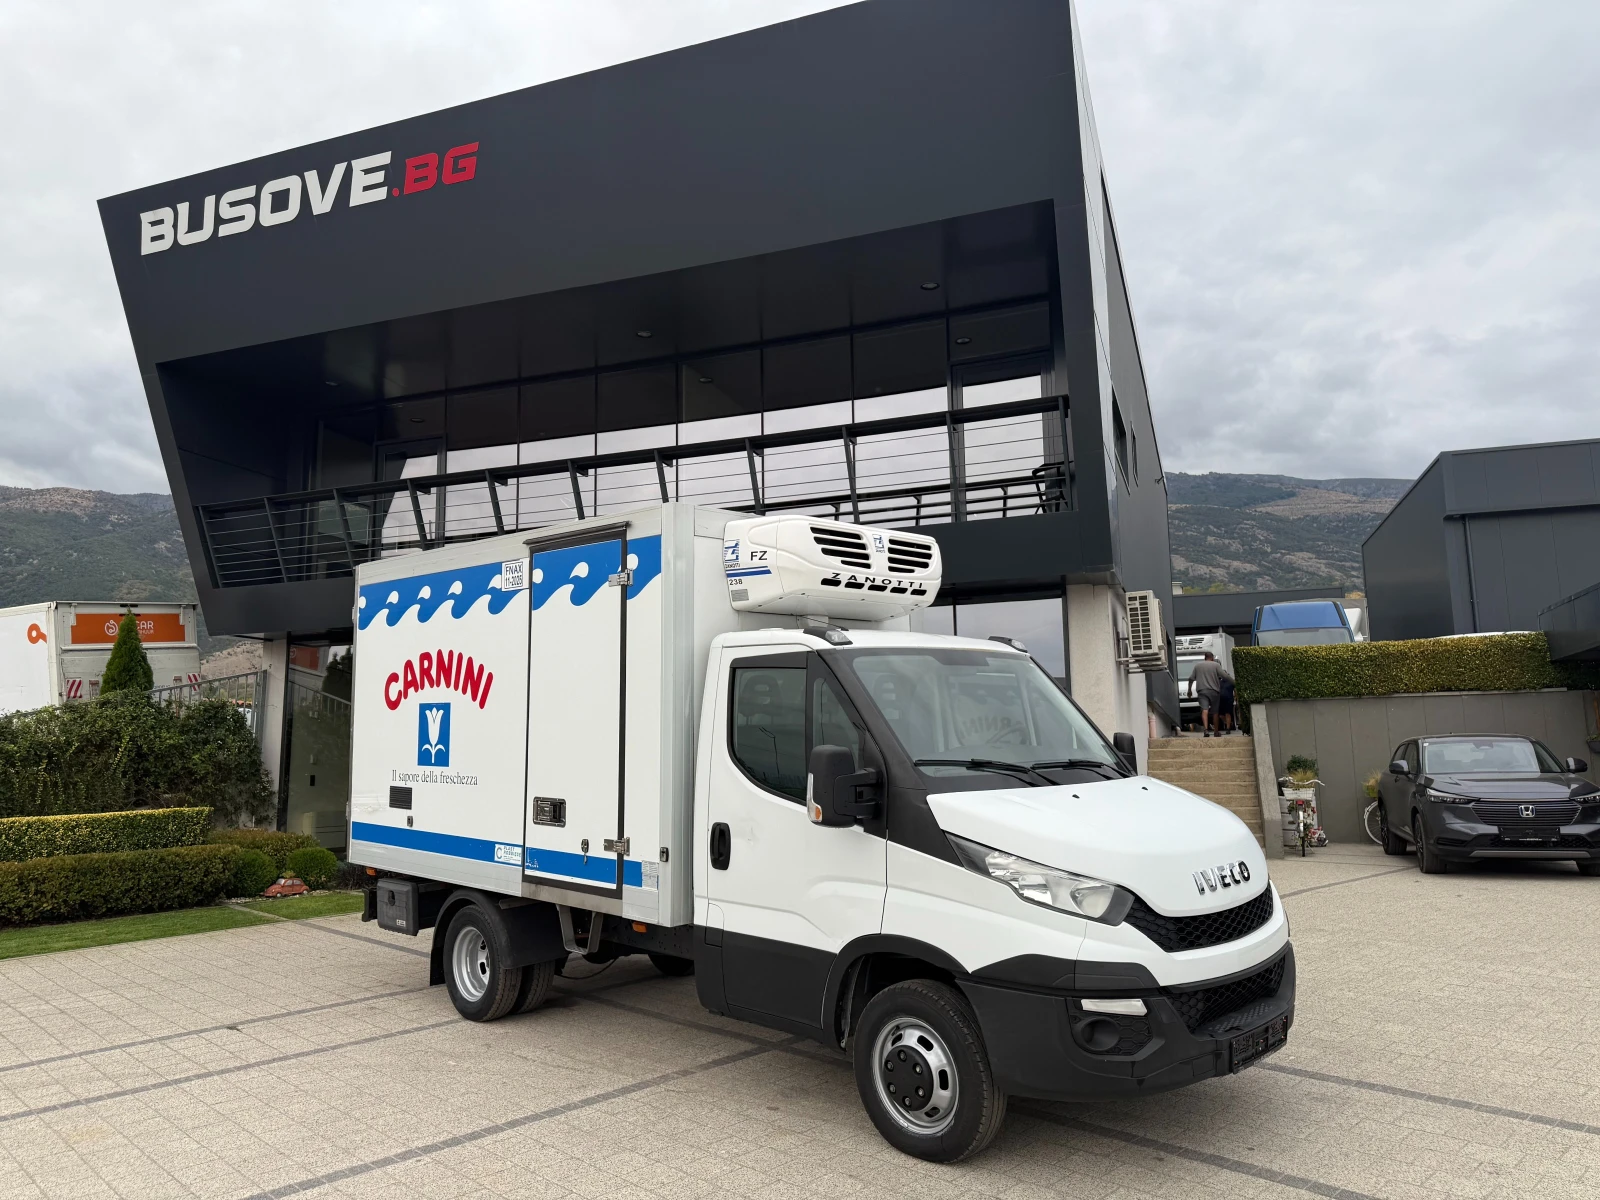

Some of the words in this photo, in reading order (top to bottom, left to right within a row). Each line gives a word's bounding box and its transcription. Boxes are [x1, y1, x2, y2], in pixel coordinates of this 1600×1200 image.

[750, 550, 768, 561] FZ
[505, 563, 523, 576] FNAX
[728, 578, 743, 586] 238
[831, 572, 923, 589] ZANOTTI
[384, 648, 494, 711] CARNINI
[392, 769, 396, 781] Il
[399, 772, 419, 785] sapore
[421, 771, 437, 783] della
[440, 771, 478, 785] freschezza
[1192, 859, 1251, 896] IVECO
